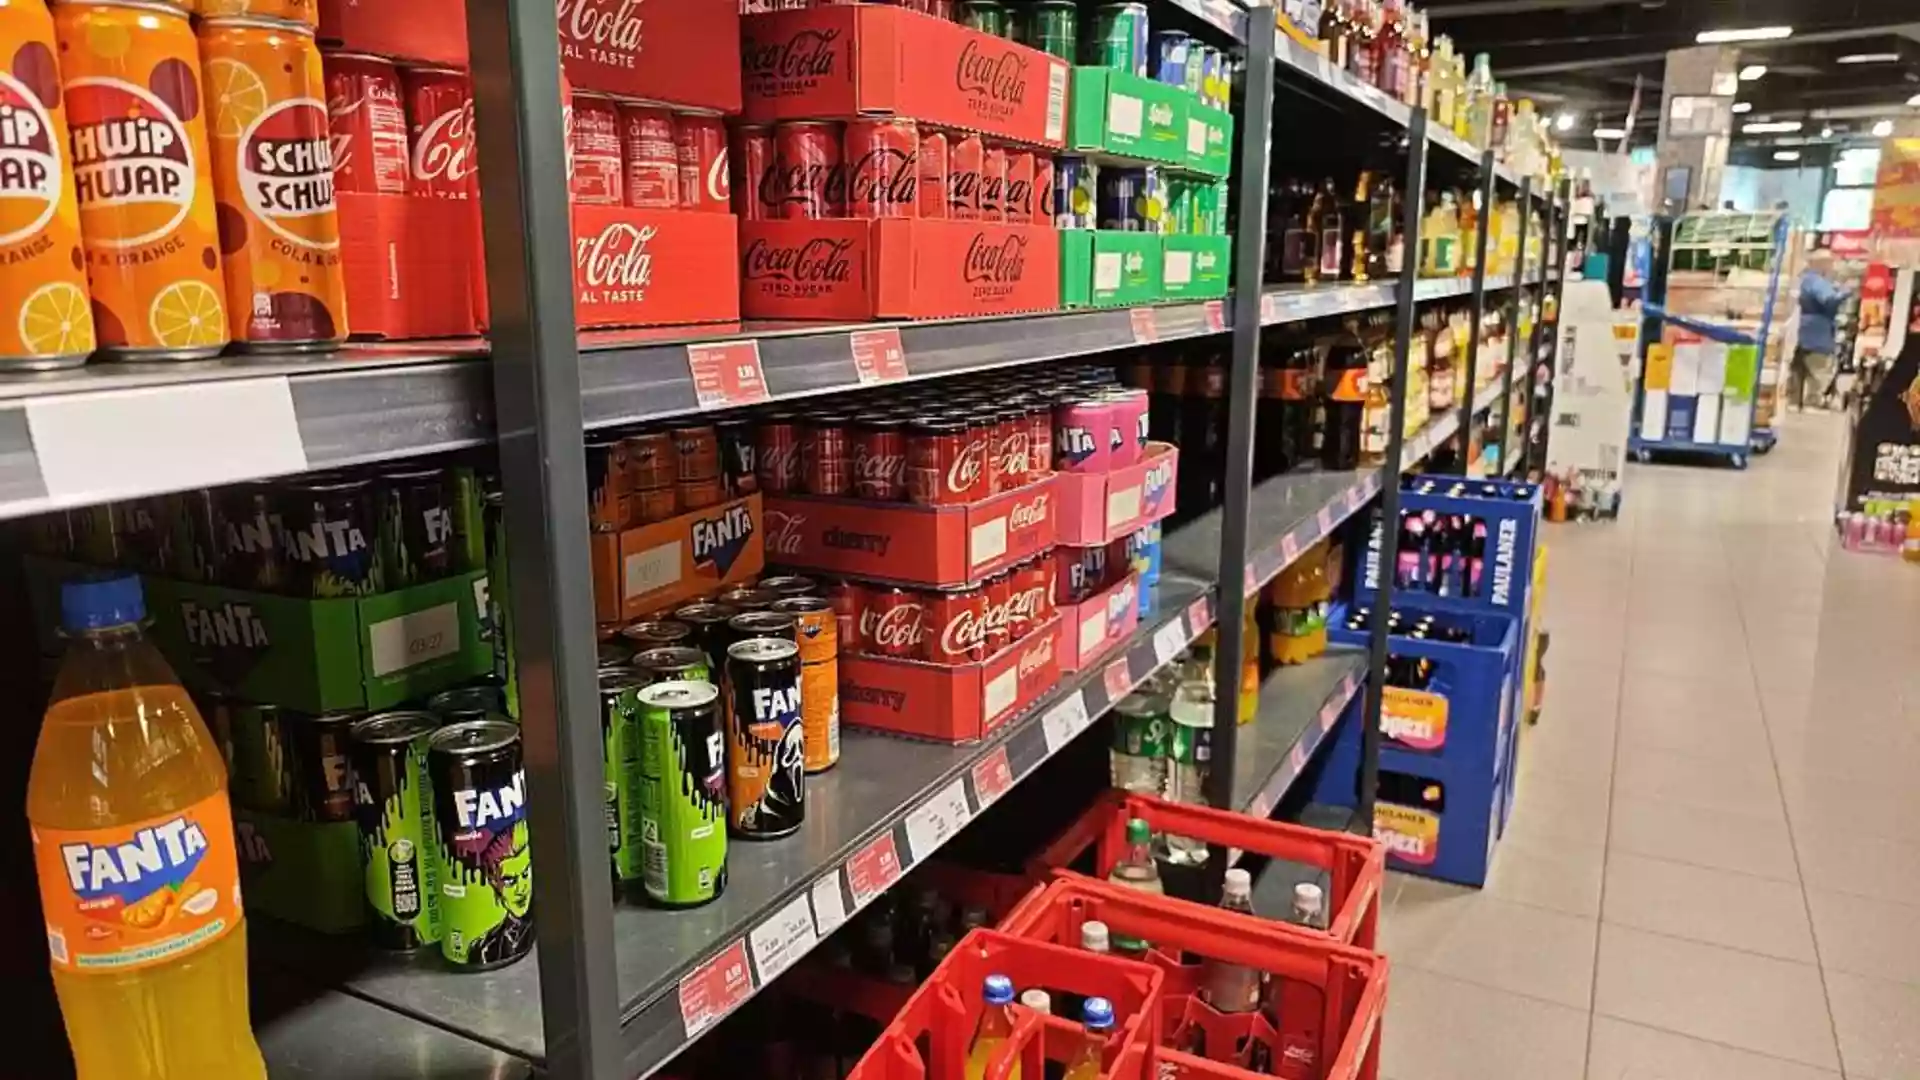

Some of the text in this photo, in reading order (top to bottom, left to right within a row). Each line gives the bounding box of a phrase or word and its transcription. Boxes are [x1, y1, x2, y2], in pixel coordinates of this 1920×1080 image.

[590, 48, 635, 69] TASTE
[117, 237, 186, 266] ORANGE
[271, 238, 311, 264] COLA
[602, 289, 644, 303] TASTE
[692, 505, 753, 558] FANTA
[1491, 518, 1517, 606] PAULANER
[181, 602, 270, 648] FANTA
[62, 817, 207, 891] FANTA
